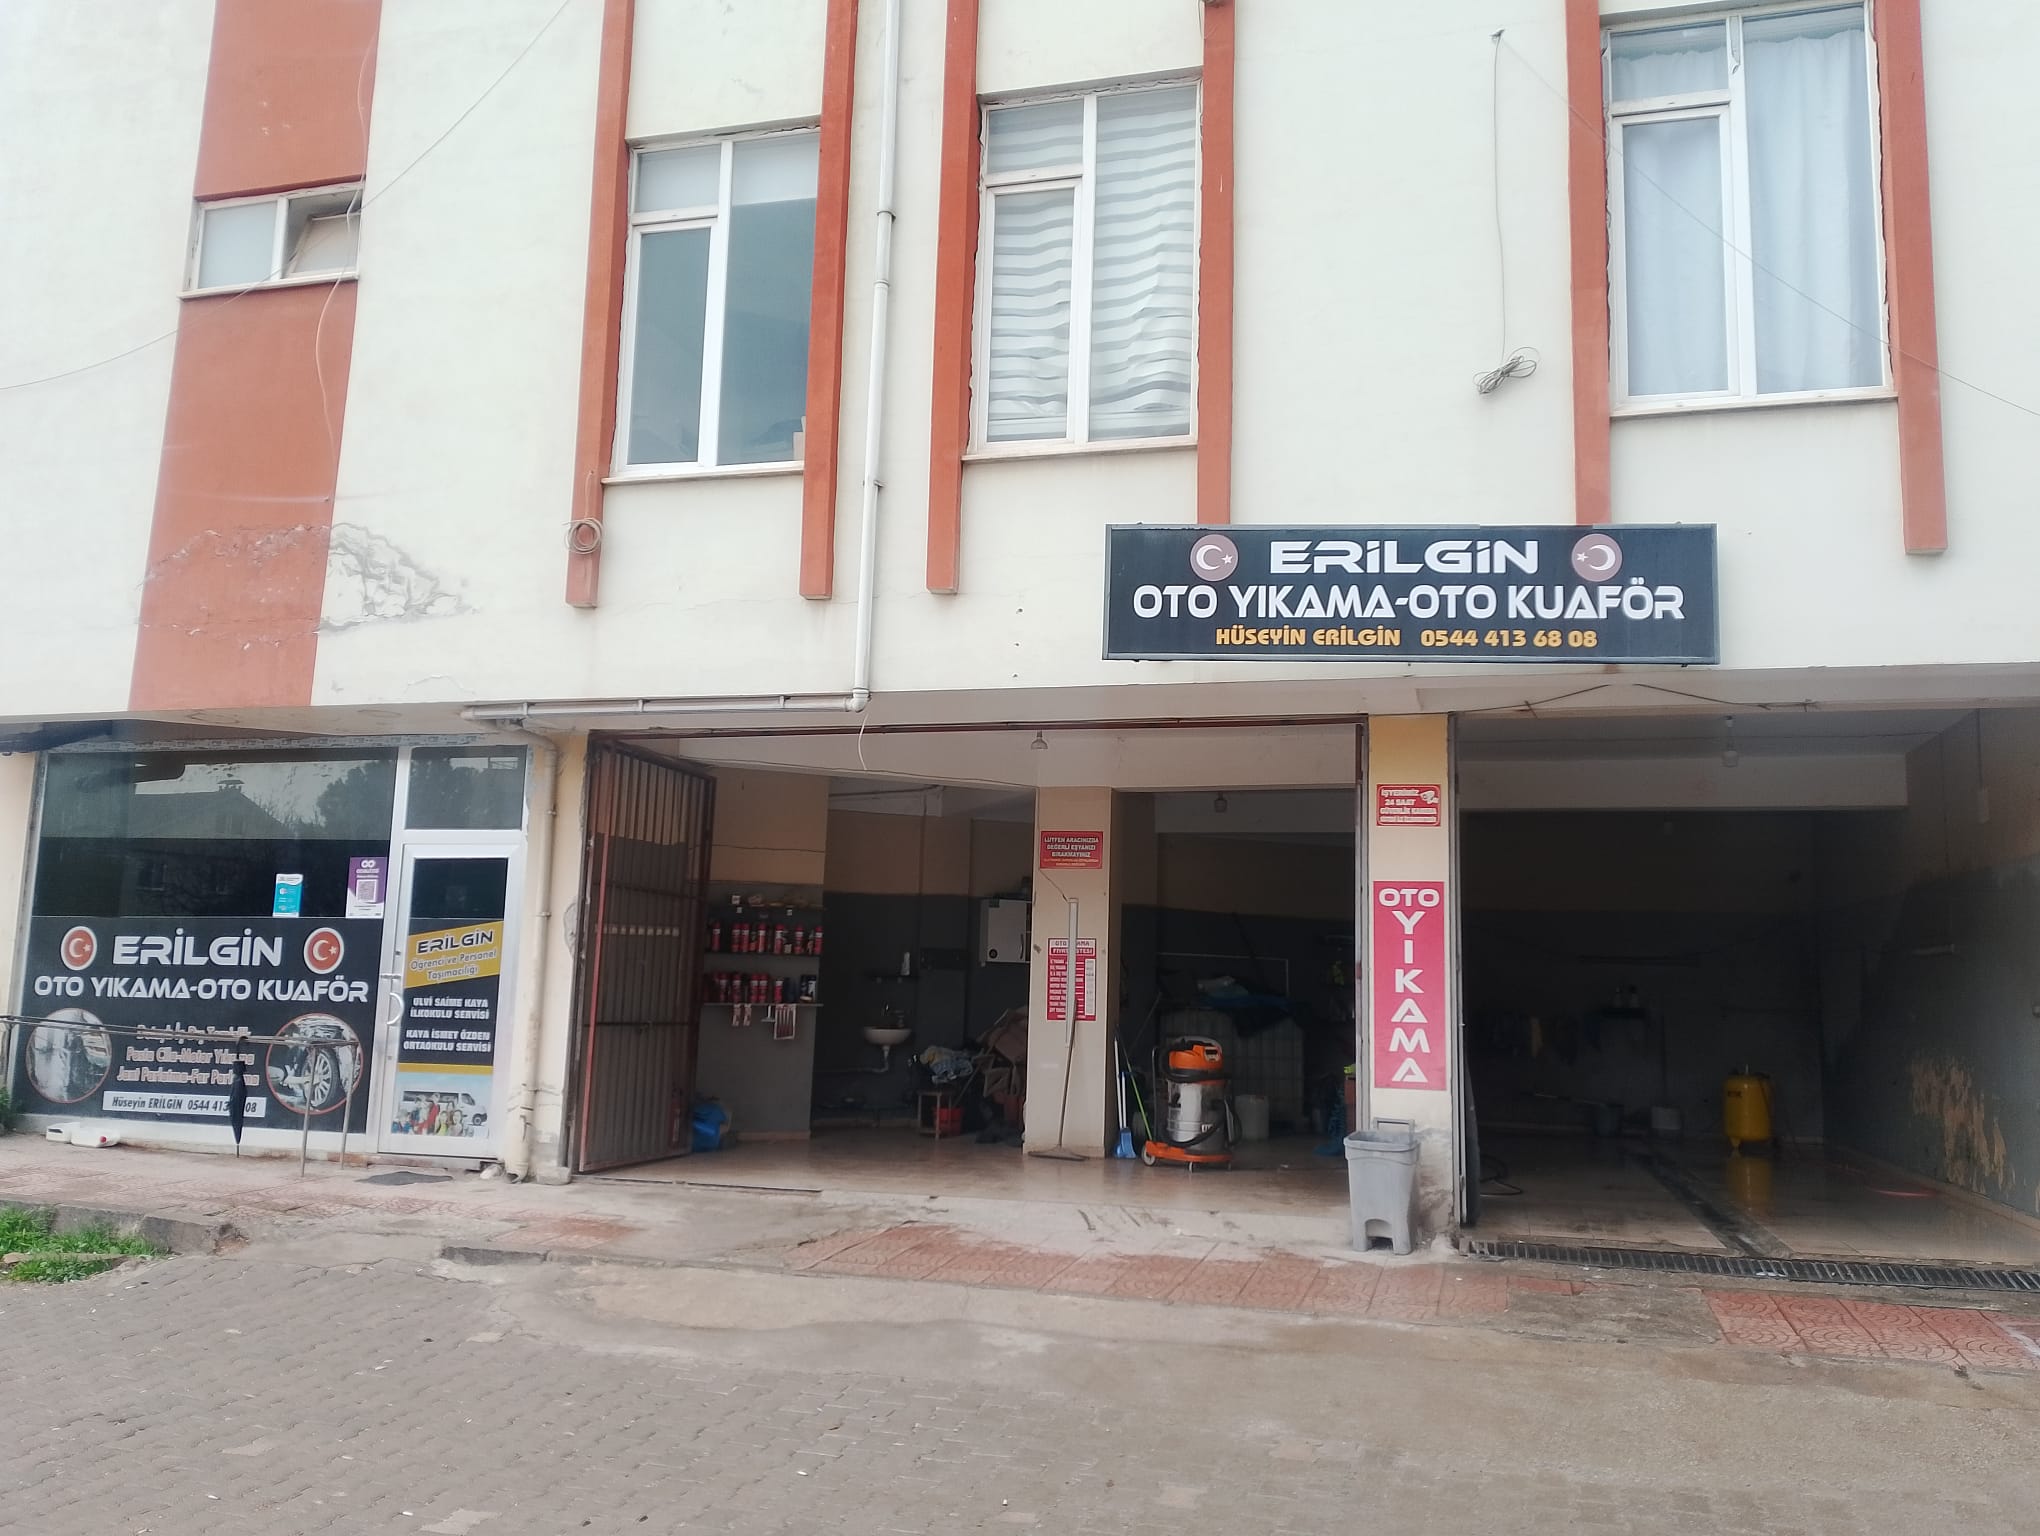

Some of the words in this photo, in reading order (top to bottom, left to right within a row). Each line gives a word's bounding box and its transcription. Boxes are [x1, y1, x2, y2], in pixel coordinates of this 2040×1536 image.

[1133, 584, 1218, 618] OTO
[1228, 584, 1497, 619] YIKAMA-OTO
[1507, 577, 1685, 620] KUAFÖR
[1216, 624, 1306, 645] HÜSEYİN
[1312, 624, 1401, 646] ERİLGİN
[1420, 629, 1479, 647] 0544
[1484, 630, 1526, 647] 413
[1532, 630, 1562, 647] 68
[1567, 630, 1598, 647] 08
[1378, 888, 1440, 907] OTO
[112, 928, 283, 967] ERİLGİN
[416, 929, 494, 954] ERİLGİN
[459, 949, 497, 962] Personel
[34, 975, 84, 997] OTO
[257, 974, 369, 1003] KUAFÖR
[1389, 910, 1431, 1084] YIKAMA
[210, 1068, 260, 1086] Parlma
[112, 1096, 146, 1111] Hüseyin
[149, 1095, 183, 1110] ERİLGİN
[187, 1100, 210, 1111] 0544
[212, 1101, 231, 1112] 413
[245, 1102, 257, 1113] 08
